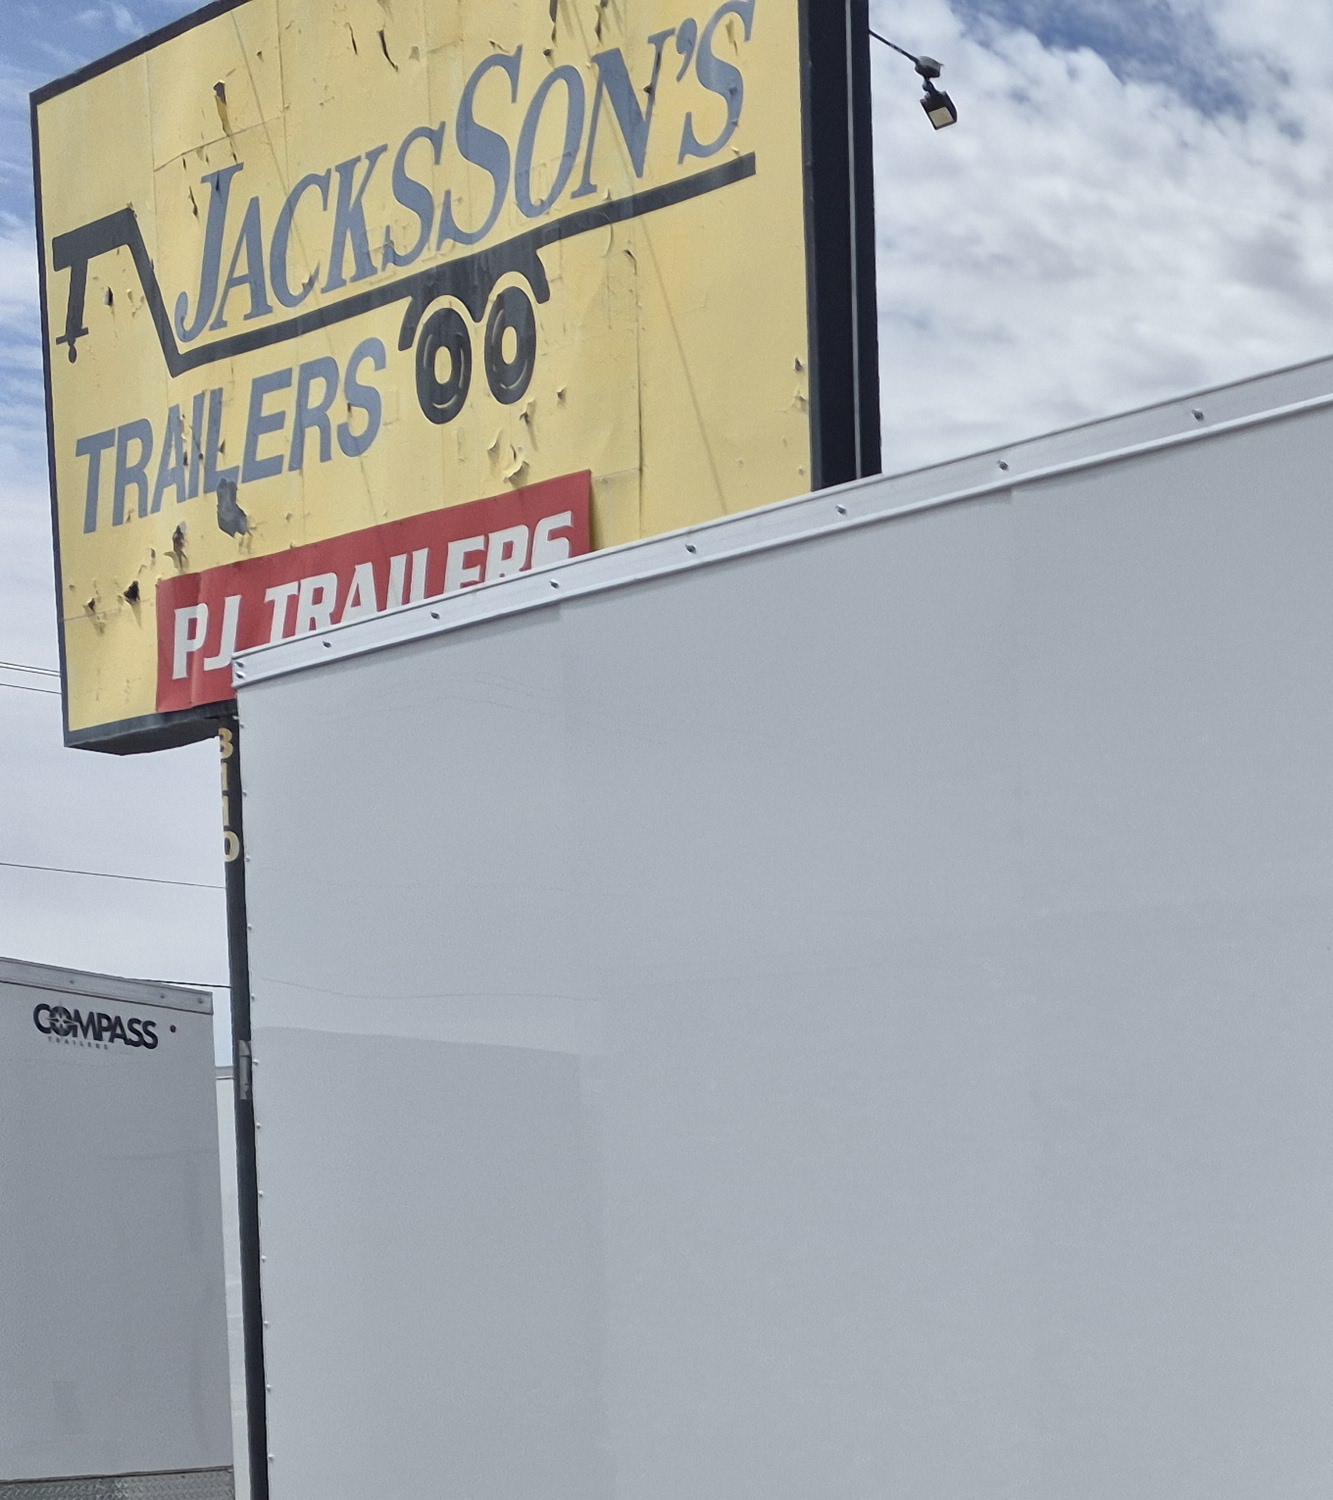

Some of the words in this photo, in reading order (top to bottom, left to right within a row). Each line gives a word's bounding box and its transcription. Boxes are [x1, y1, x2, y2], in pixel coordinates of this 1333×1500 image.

[75, 337, 387, 534] TRAILERS
[171, 594, 242, 680] PJ
[33, 1003, 158, 1050] COMPASS
